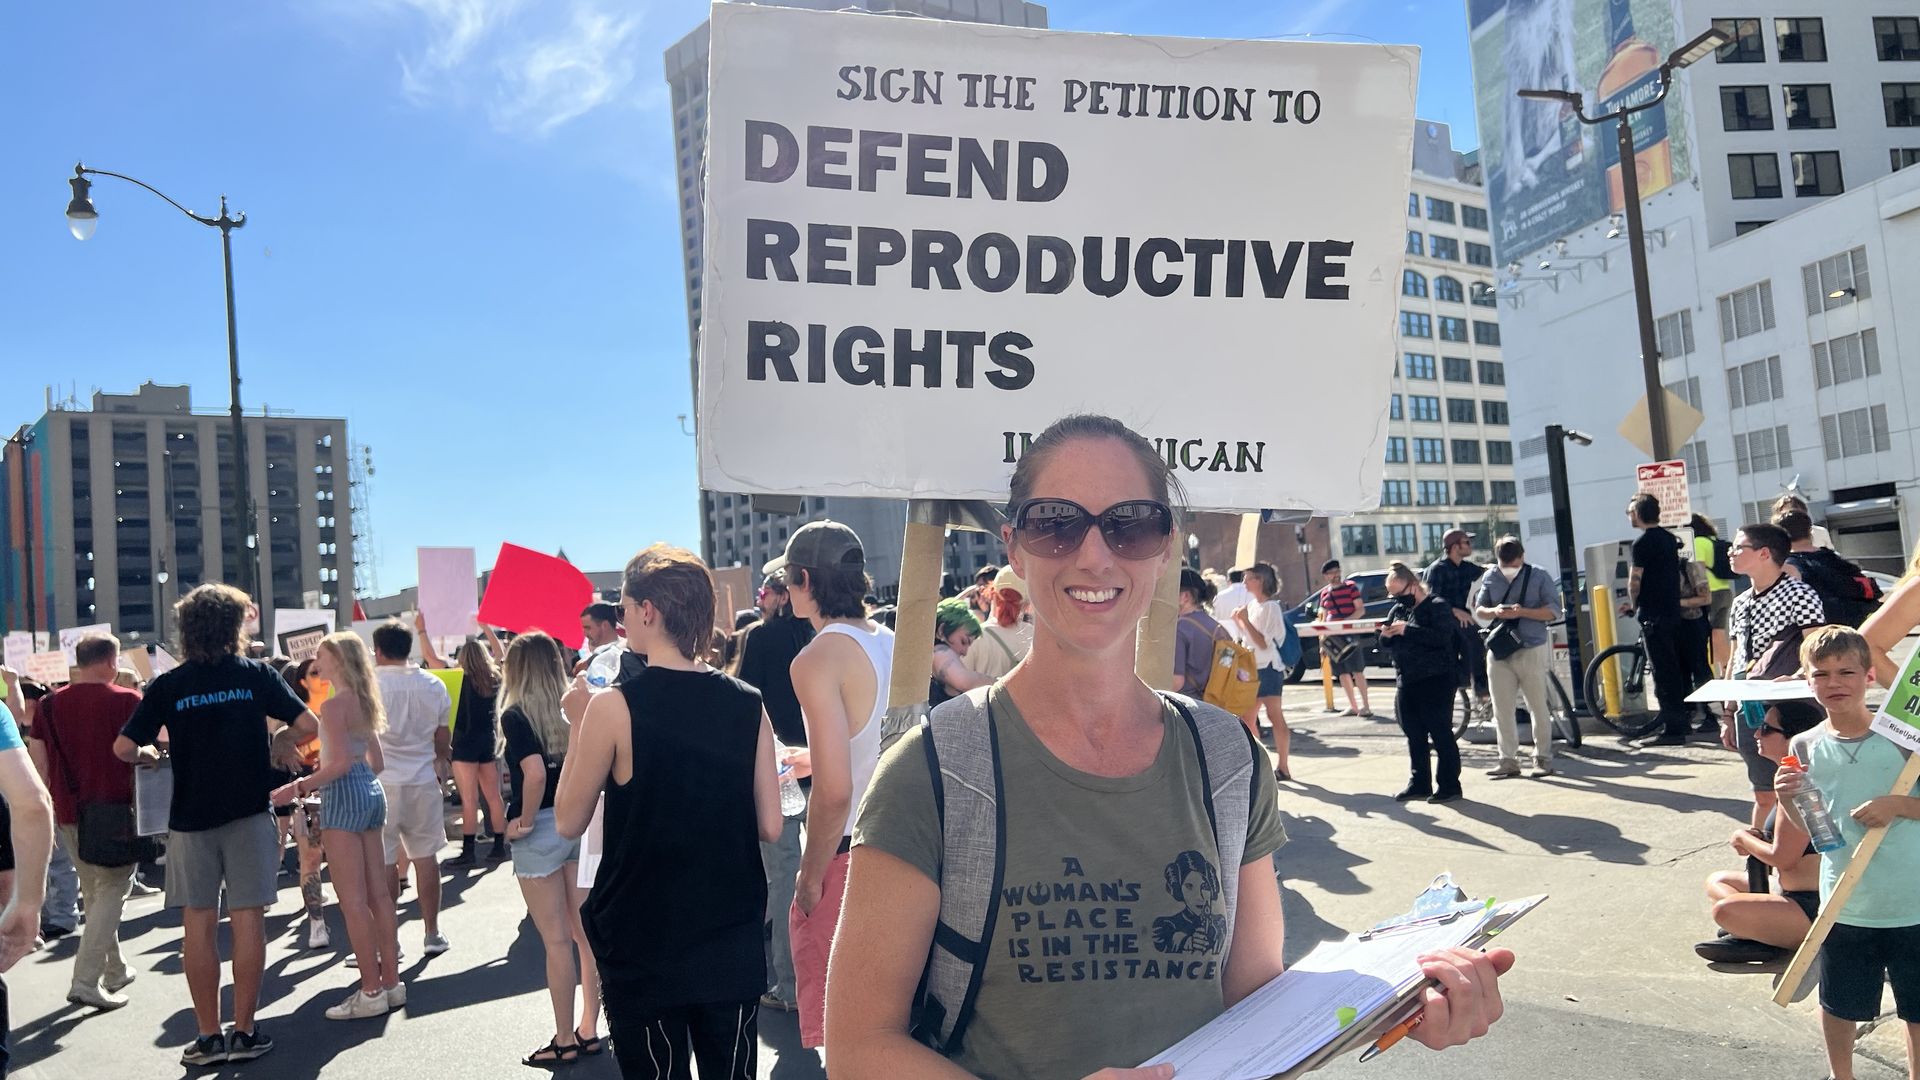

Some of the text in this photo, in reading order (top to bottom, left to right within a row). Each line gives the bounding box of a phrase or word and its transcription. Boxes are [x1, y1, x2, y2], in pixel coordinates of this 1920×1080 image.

[837, 66, 1321, 125] SIGN THE PETITION TO
[744, 119, 1069, 203] DEFEND
[746, 218, 1354, 301] REPRODUCTIVE
[746, 319, 1035, 391] RIGHTS
[176, 688, 253, 712] #TEAMDANA
[1062, 857, 1084, 876] A
[1011, 908, 1133, 932] PLACE
[1009, 933, 1139, 958] IS IN THE
[1018, 959, 1217, 983] RESISTANCE
